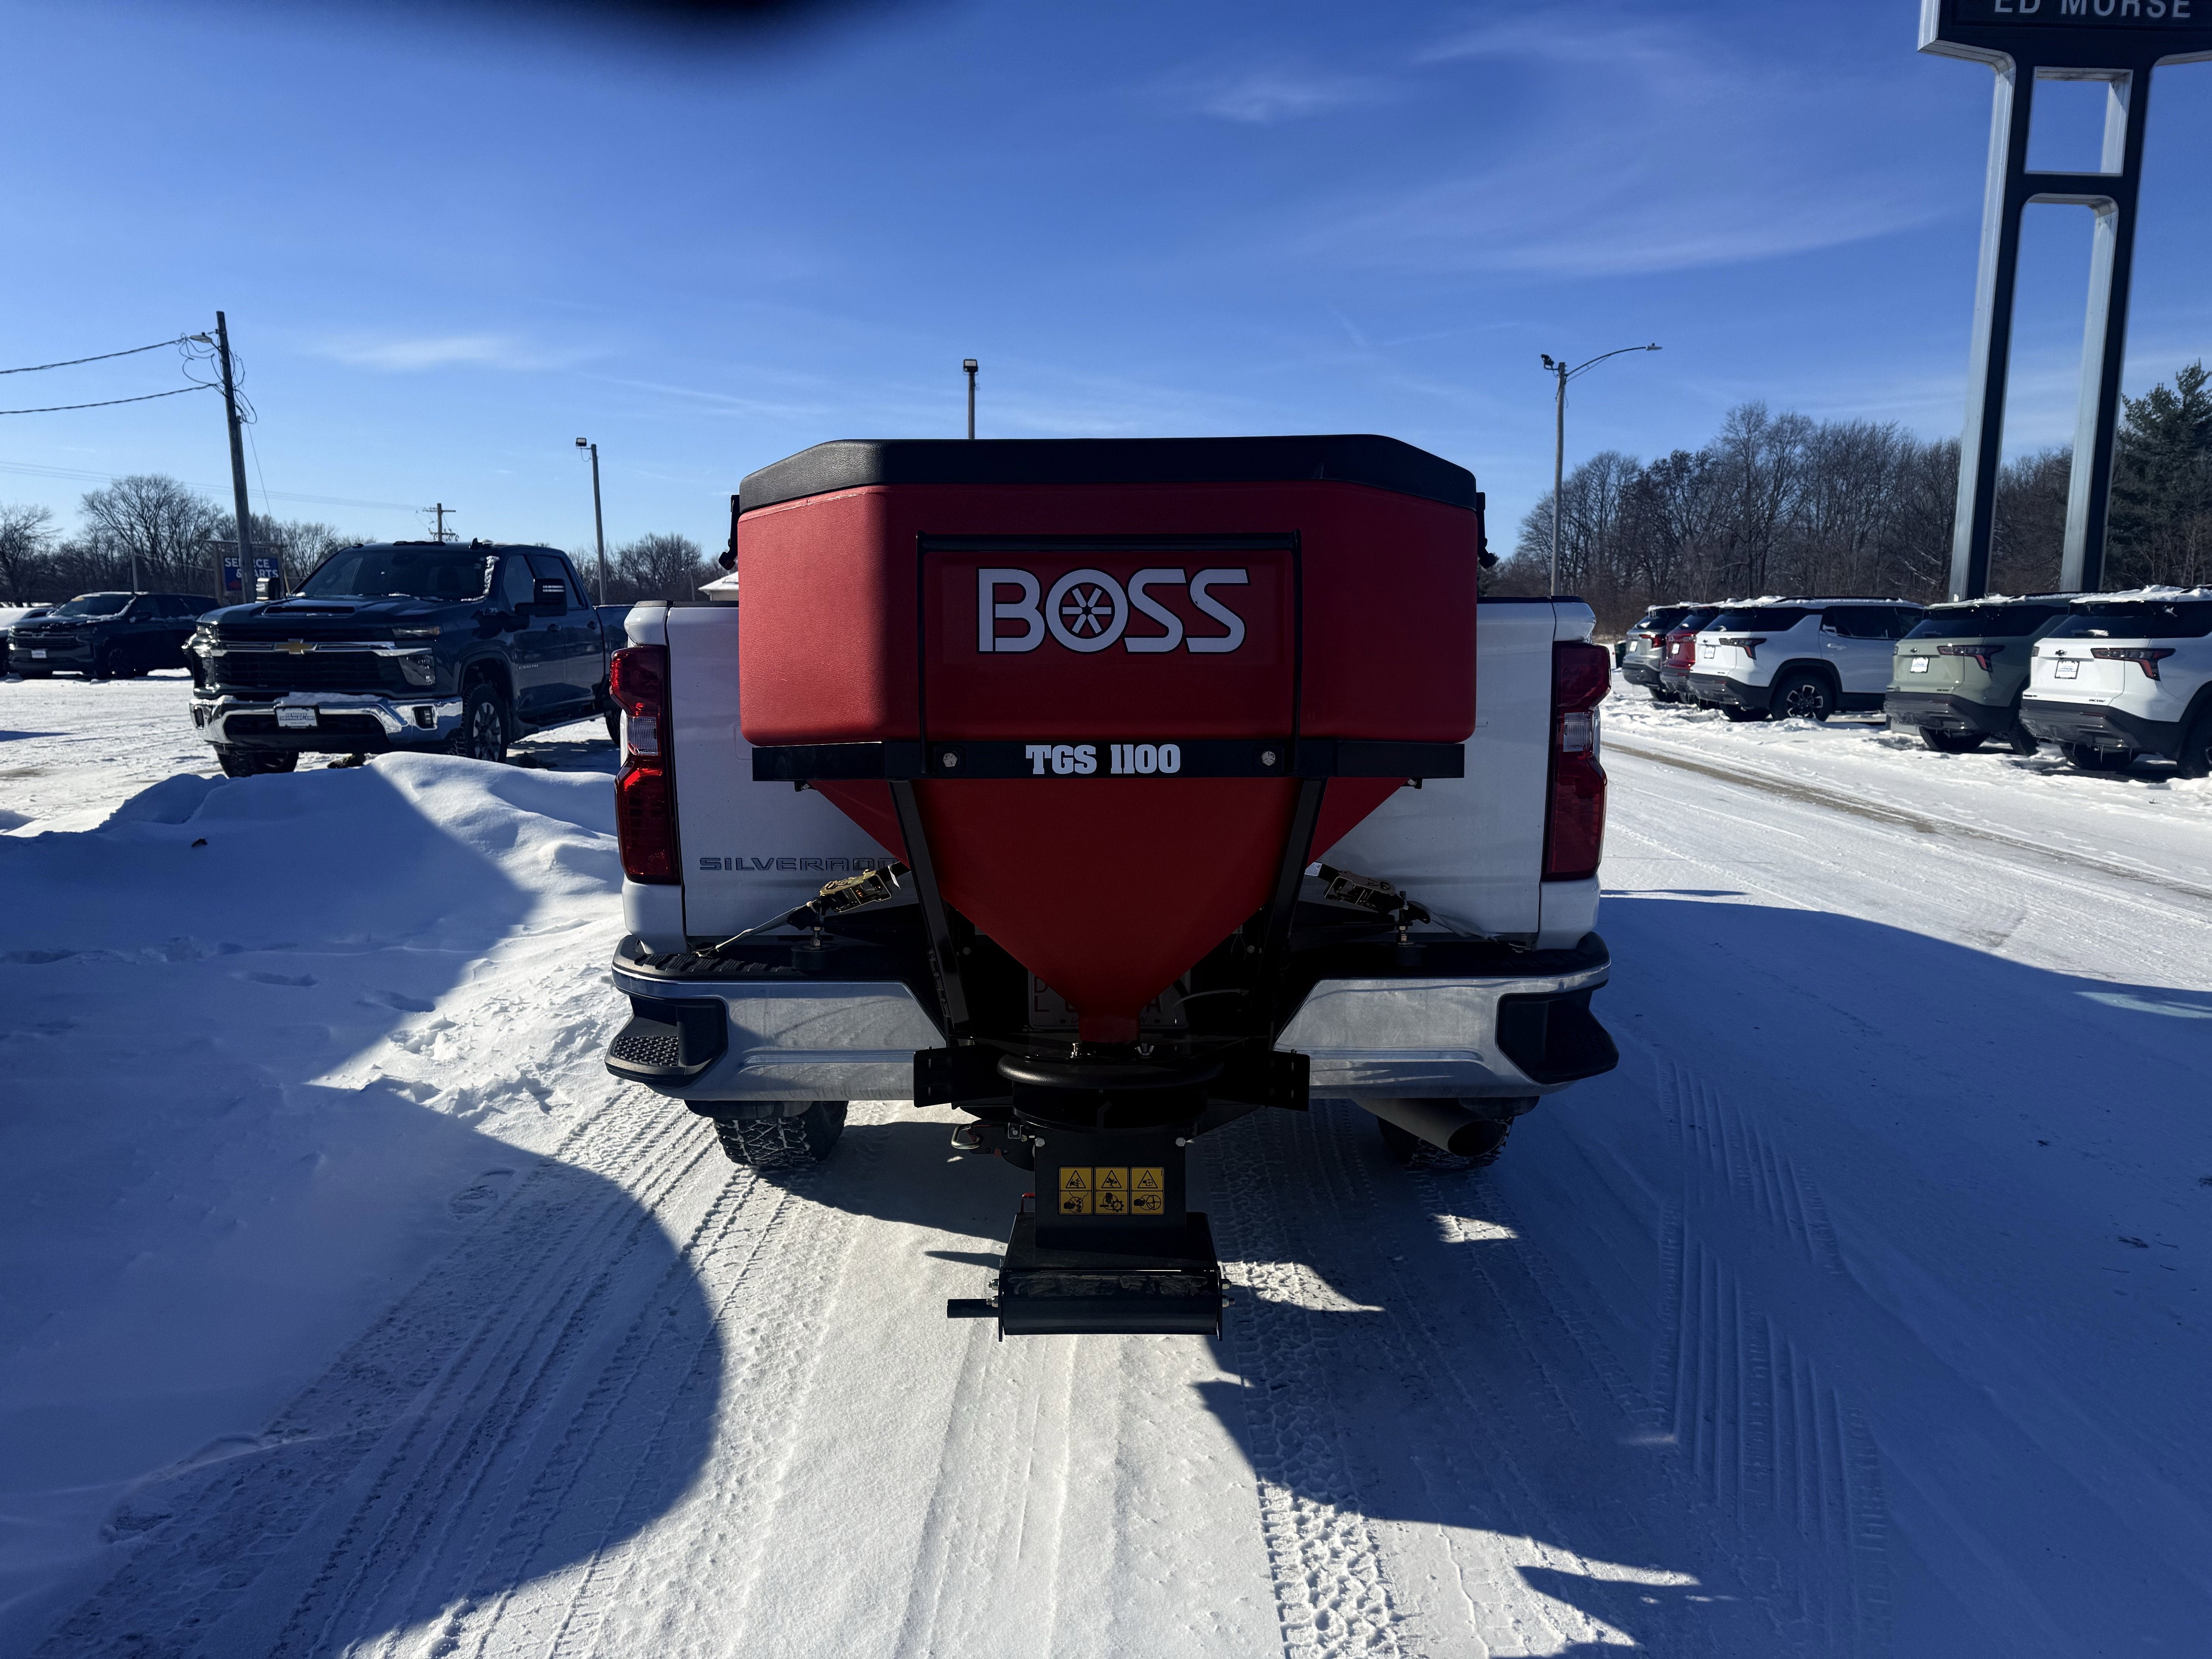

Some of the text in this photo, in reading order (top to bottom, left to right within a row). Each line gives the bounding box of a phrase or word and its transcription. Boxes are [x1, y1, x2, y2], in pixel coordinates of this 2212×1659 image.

[2061, 0, 2190, 18] MORSE
[225, 557, 270, 568] SEICE
[254, 568, 279, 578] ARTS
[977, 567, 1250, 654] BOSS
[1026, 744, 1181, 775] TGS 1100
